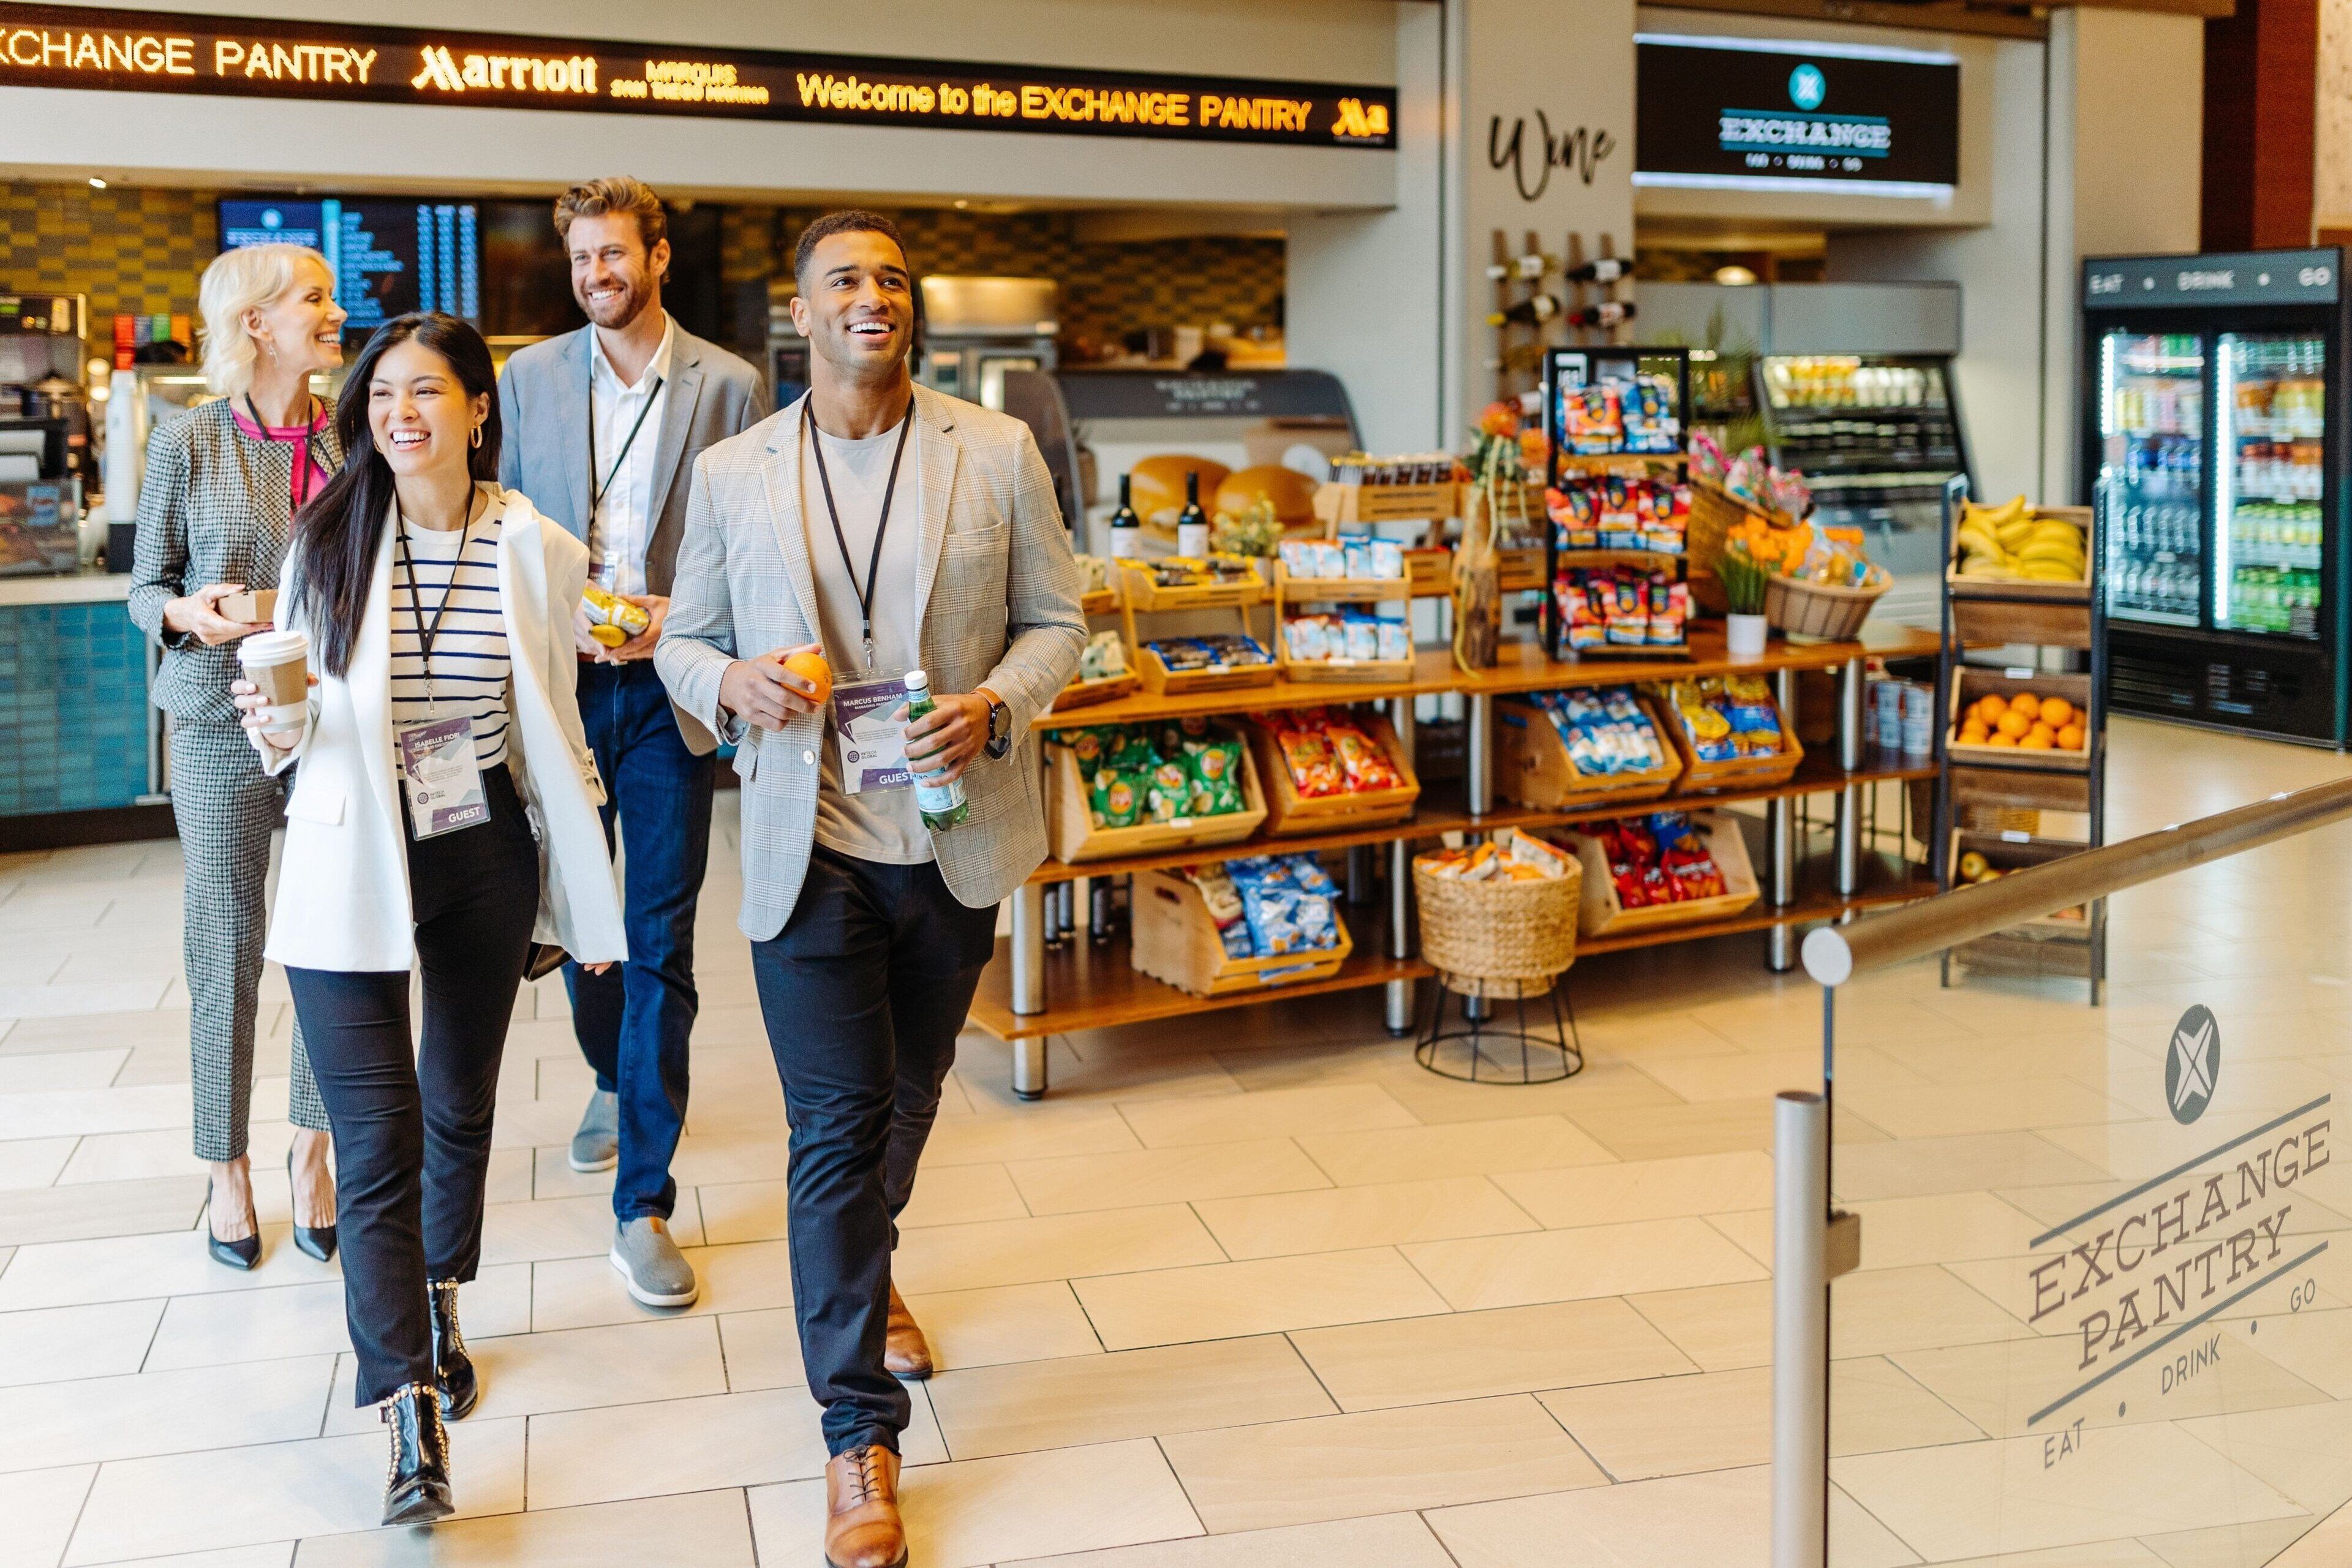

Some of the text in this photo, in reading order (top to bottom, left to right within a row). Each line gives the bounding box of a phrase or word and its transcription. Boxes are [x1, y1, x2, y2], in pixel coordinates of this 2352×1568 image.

[216, 40, 377, 83] PANTRY
[411, 45, 598, 94] Marriott
[796, 73, 935, 113] Welcome
[938, 83, 968, 114] to
[973, 83, 1017, 117] the
[1022, 86, 1190, 126] EXCHANGE
[1200, 95, 1313, 132] PANTRY
[1488, 108, 1615, 202] Wine
[1719, 117, 1892, 149] EXCHANGE
[843, 697, 872, 707] MARCUS
[873, 692, 903, 703] BENHAM
[415, 731, 461, 749] ISABELLE FIORI
[879, 772, 913, 785] GUEST
[448, 807, 480, 823] GUEST
[2029, 1119, 2330, 1325] EXCHANGE
[2078, 1205, 2292, 1371] PANTRY
[2045, 1278, 2315, 1470] EAT DRINK GO
